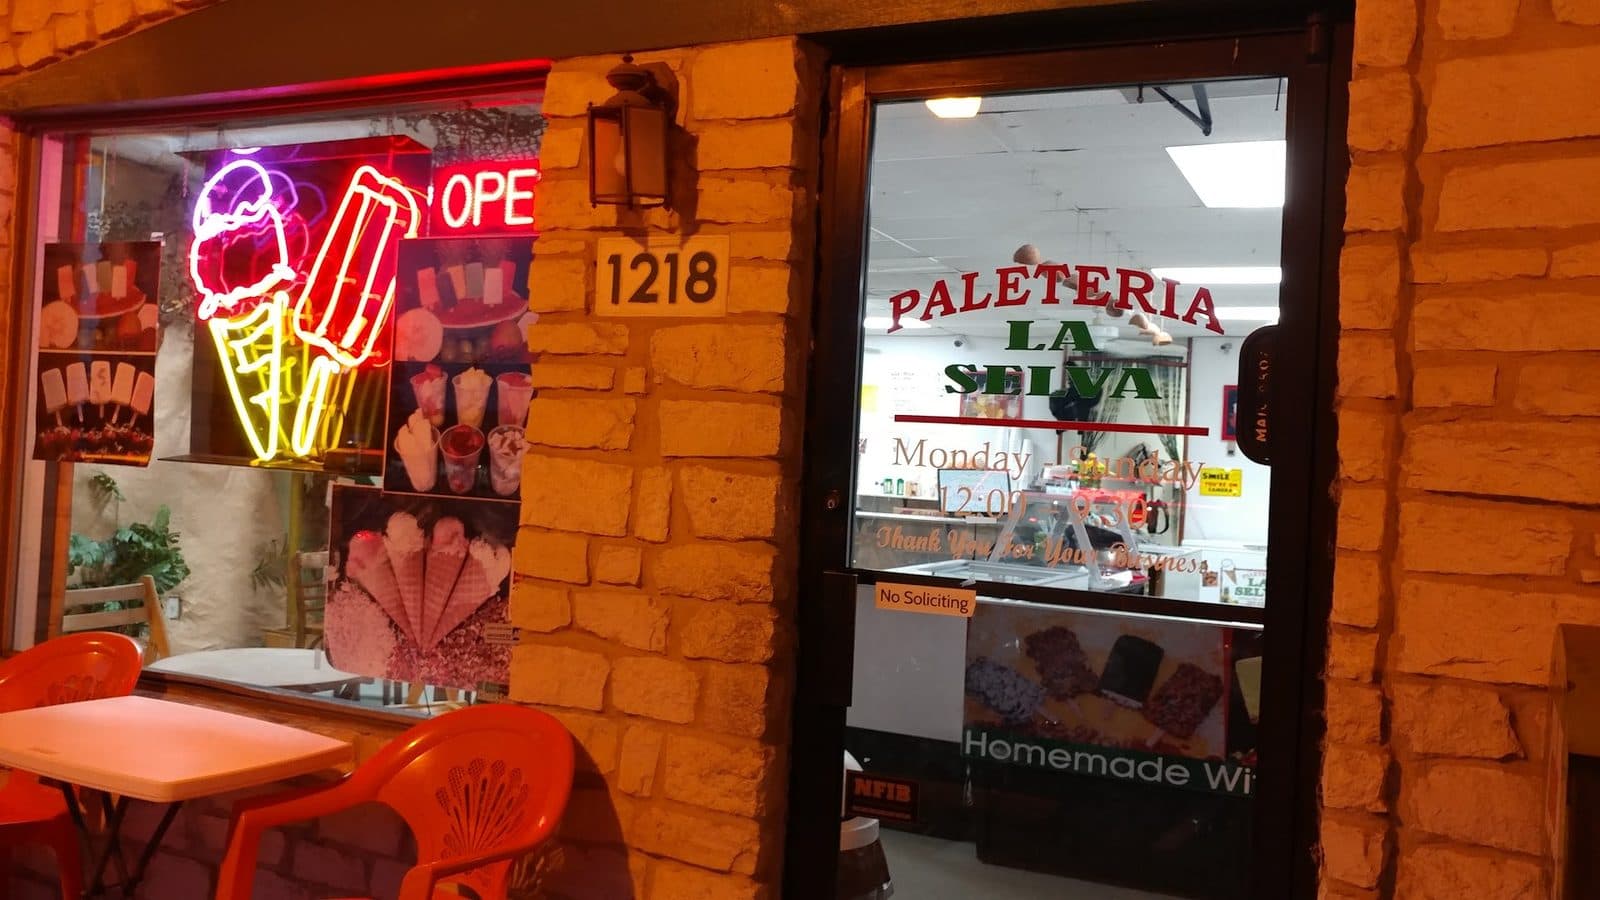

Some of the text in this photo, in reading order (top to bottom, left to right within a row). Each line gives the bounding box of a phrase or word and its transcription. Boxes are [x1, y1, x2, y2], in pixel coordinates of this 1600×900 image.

[441, 169, 537, 228] OPE
[607, 252, 717, 305] 1218
[887, 263, 1224, 335] PALETERIA
[1005, 320, 1099, 351] LA
[944, 364, 1163, 400] SELVA
[892, 437, 1032, 480] Monday
[1068, 445, 1206, 491] Sunday
[1202, 472, 1230, 481] SMILE
[938, 485, 1027, 520] 12:00
[1071, 494, 1148, 530] 9:30
[876, 525, 943, 553] Thank
[947, 529, 992, 561] You
[1042, 535, 1098, 568] Your
[1110, 541, 1209, 574] Business
[880, 588, 969, 614] No Soliciting
[1234, 586, 1266, 597] SEL
[964, 729, 1191, 786] Homemade
[854, 777, 912, 803] NFIB
